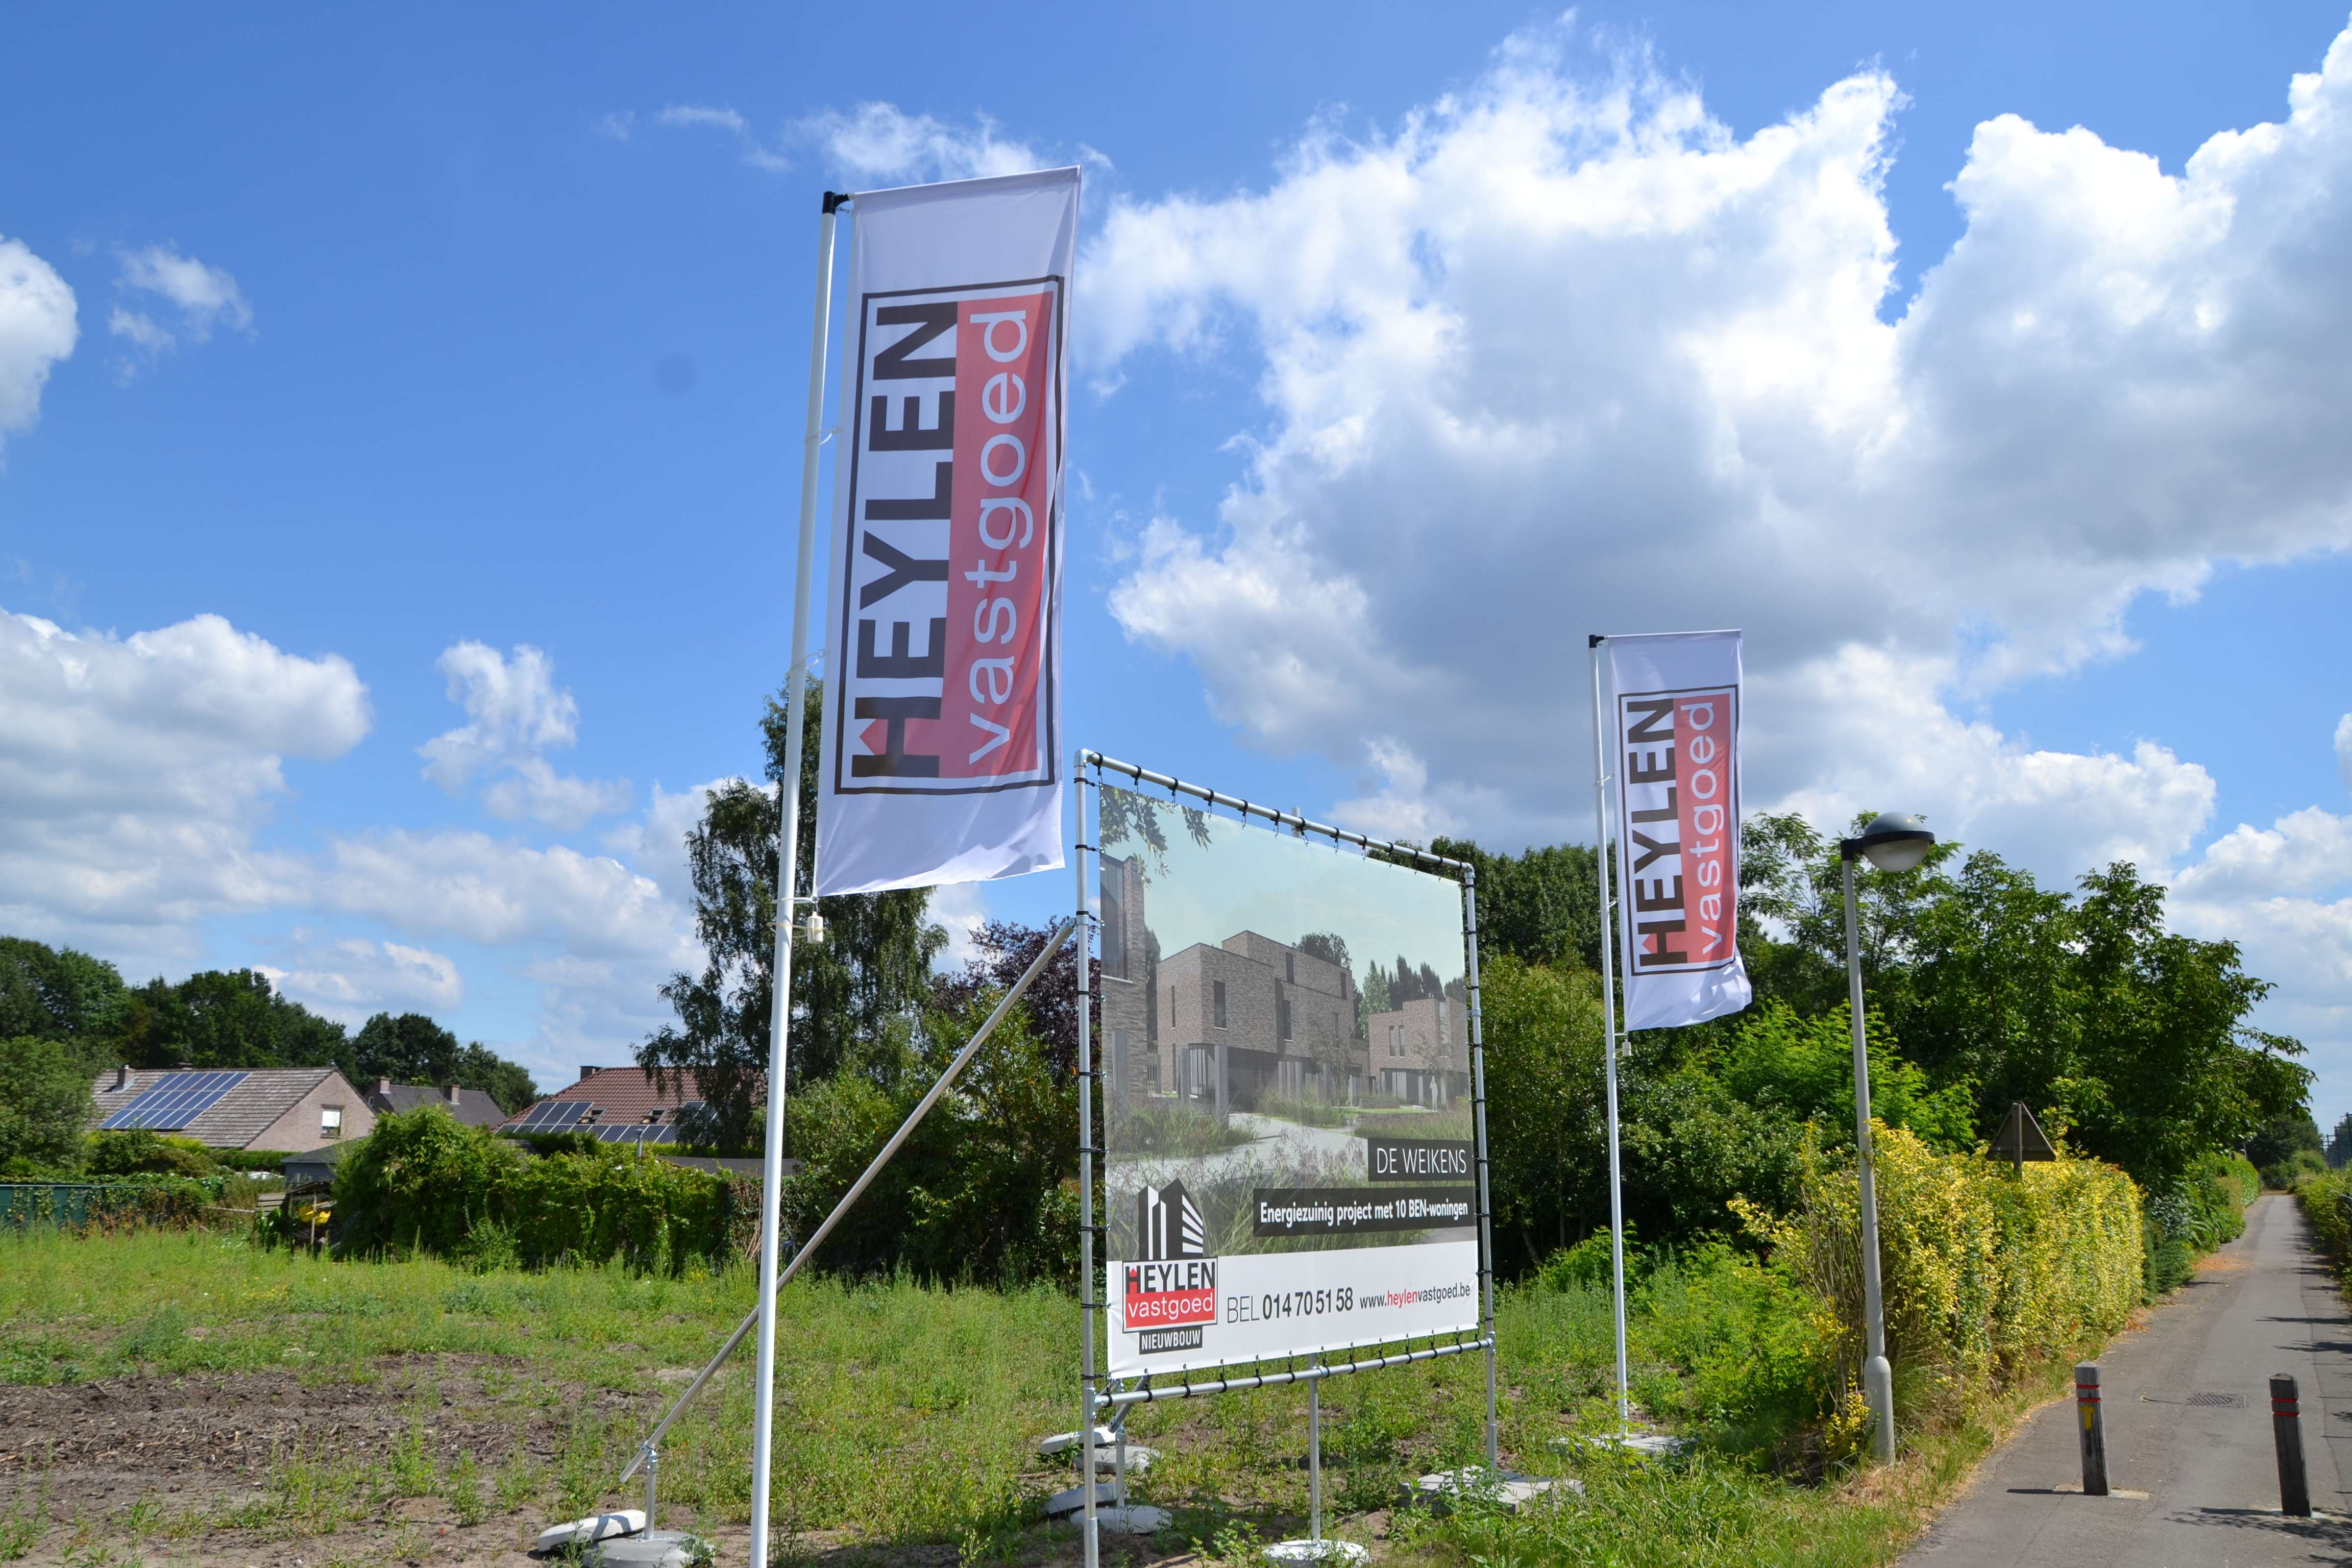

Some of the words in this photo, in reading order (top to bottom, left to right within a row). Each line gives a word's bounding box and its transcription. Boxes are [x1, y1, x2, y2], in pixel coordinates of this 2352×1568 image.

[851, 301, 959, 779] HEYLEN
[964, 309, 1034, 765] vastgoed
[1626, 698, 1688, 966] HEYLEN
[1680, 701, 1724, 955] vastgoed
[1377, 1148, 1398, 1173] DE
[1402, 1148, 1466, 1174] WEIKENS
[1260, 1201, 1334, 1228] Energiezuinig
[1337, 1200, 1372, 1226] project
[1375, 1202, 1393, 1219] met
[1395, 1199, 1406, 1218] 10
[1409, 1197, 1468, 1220] BEN-woningen
[1125, 1262, 1215, 1294] HEYLEN
[1128, 1292, 1213, 1320] vastgoed
[1227, 1295, 1260, 1324] BEL
[1360, 1282, 1471, 1309] www.heylenvastgoed.be
[1141, 1329, 1201, 1351] NIEUWBOUW
